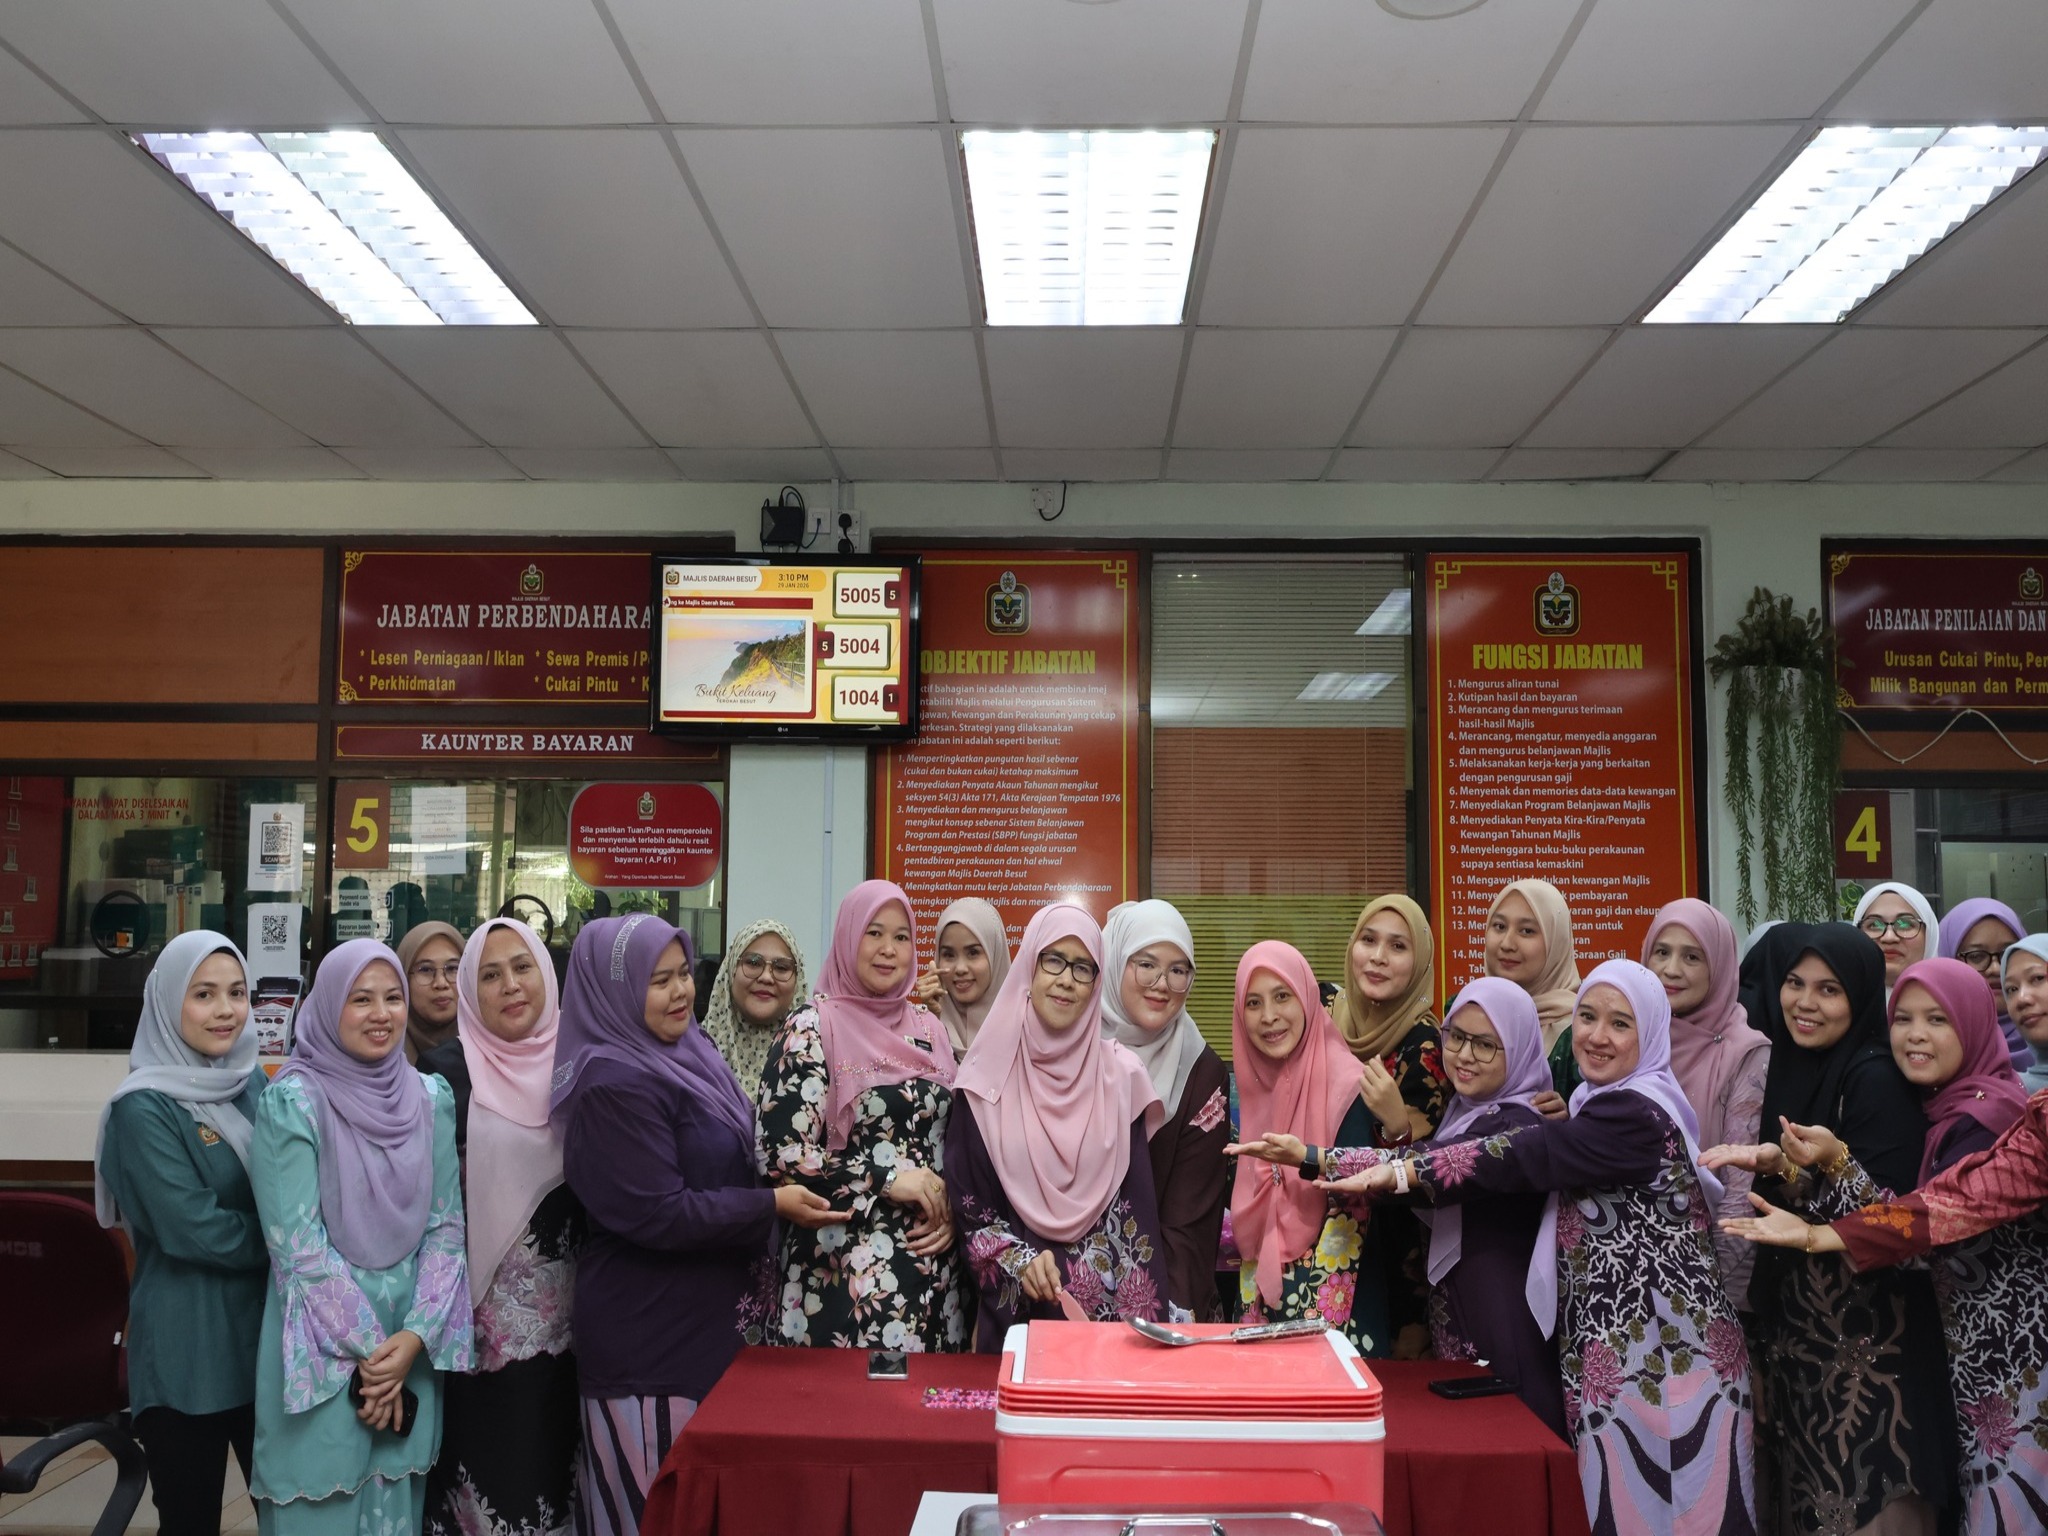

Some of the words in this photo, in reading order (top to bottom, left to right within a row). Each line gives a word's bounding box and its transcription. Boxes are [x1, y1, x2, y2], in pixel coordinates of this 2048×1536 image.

[840, 587, 880, 603] 5005
[889, 590, 895, 600] 5
[377, 604, 470, 627] JABATAN
[1865, 608, 1929, 630] JABATAN
[1935, 608, 2012, 630] PENILAIAN
[2018, 609, 2045, 631] DAN
[822, 641, 827, 651] 5
[840, 638, 879, 653] 5004
[371, 649, 407, 665] Lesen
[494, 650, 523, 665] Iklan
[546, 650, 579, 666] Sewa
[586, 650, 628, 666] Premis
[920, 650, 1008, 674] OBJEKTIF
[1012, 650, 1095, 674] JABATAN
[1472, 644, 1548, 669] FUNGSI
[1553, 644, 1642, 669] JABATAN
[1885, 650, 1932, 666] Urusan
[1939, 650, 1977, 666] Cukai
[1984, 651, 2022, 670] Pintu,
[370, 675, 455, 691] Perkhidmatan
[546, 675, 580, 691] Cukai
[586, 676, 618, 691] Pintu
[1448, 679, 1455, 688] 1.
[1458, 679, 1504, 690] Mengurus
[1506, 678, 1532, 688] aliran
[1535, 679, 1558, 688] tunai
[1870, 677, 1901, 693] Milik
[1909, 677, 1976, 696] Bangunan
[1983, 677, 2007, 693] dan
[694, 683, 727, 699] Bukit
[728, 684, 776, 703] Keluang
[839, 689, 878, 705] 1004
[888, 693, 892, 702] 1
[1448, 692, 1456, 701] 2.
[1458, 692, 1494, 703] Kutipan
[1496, 692, 1518, 701] hasil
[1520, 692, 1537, 701] dan
[1540, 692, 1577, 703] bayaran
[1448, 705, 1456, 713] 3.
[1458, 704, 1509, 716] Merancang
[1512, 704, 1529, 713] dan
[1532, 707, 1578, 716] mengurus
[1580, 704, 1622, 713] terimaan
[1458, 718, 1504, 728] hasil-hasil
[1507, 718, 1534, 730] Majlis
[421, 734, 524, 750] KAUNTER
[532, 734, 633, 750] BAYARAN
[1448, 731, 1456, 740] 4.
[1459, 731, 1512, 742] Merancang,
[1515, 732, 1562, 742] mengatur,
[1565, 731, 1610, 742] menyedia
[1612, 733, 1656, 742] anggaran
[1459, 745, 1476, 754] dan
[1478, 747, 1525, 756] mengurus
[1527, 745, 1581, 756] belanjawan
[1583, 745, 1610, 756] Majlis
[906, 754, 983, 764] Mempertingkatkan
[984, 755, 1024, 764] pungutan
[1025, 754, 1045, 762] hasil
[1046, 754, 1078, 763] sebenar
[904, 766, 928, 775] (cukai
[973, 767, 998, 776] cukai)
[999, 767, 1032, 776] ketahap
[1034, 767, 1078, 775] maksimum
[906, 780, 960, 790] Menyediakan
[961, 780, 994, 790] Penyata
[995, 780, 1021, 788] Akaun
[1024, 780, 1058, 789] Tahunan
[1059, 780, 1097, 791] mengikut
[132, 798, 189, 809] DISELESAIKAN
[905, 793, 936, 802] seksyen
[938, 793, 959, 801] 54(3)
[960, 792, 979, 801] Akta
[982, 793, 998, 801] 171,
[1000, 793, 1019, 801] Akta
[1020, 793, 1056, 803] Kerajaan
[1059, 793, 1098, 803] Tempatan
[112, 810, 135, 820] MASA
[139, 810, 144, 820] 3
[147, 810, 170, 820] MINIT
[347, 798, 378, 852] 5
[598, 836, 636, 844] menyemak
[1845, 807, 1880, 862] 4
[577, 846, 606, 854] bayaran
[639, 846, 684, 855] meninggalkan
[614, 856, 642, 864] bayaran
[904, 868, 945, 879] kewangan
[947, 869, 971, 879] Majlis
[973, 869, 1002, 877] Daerah
[1004, 869, 1026, 877] Besut
